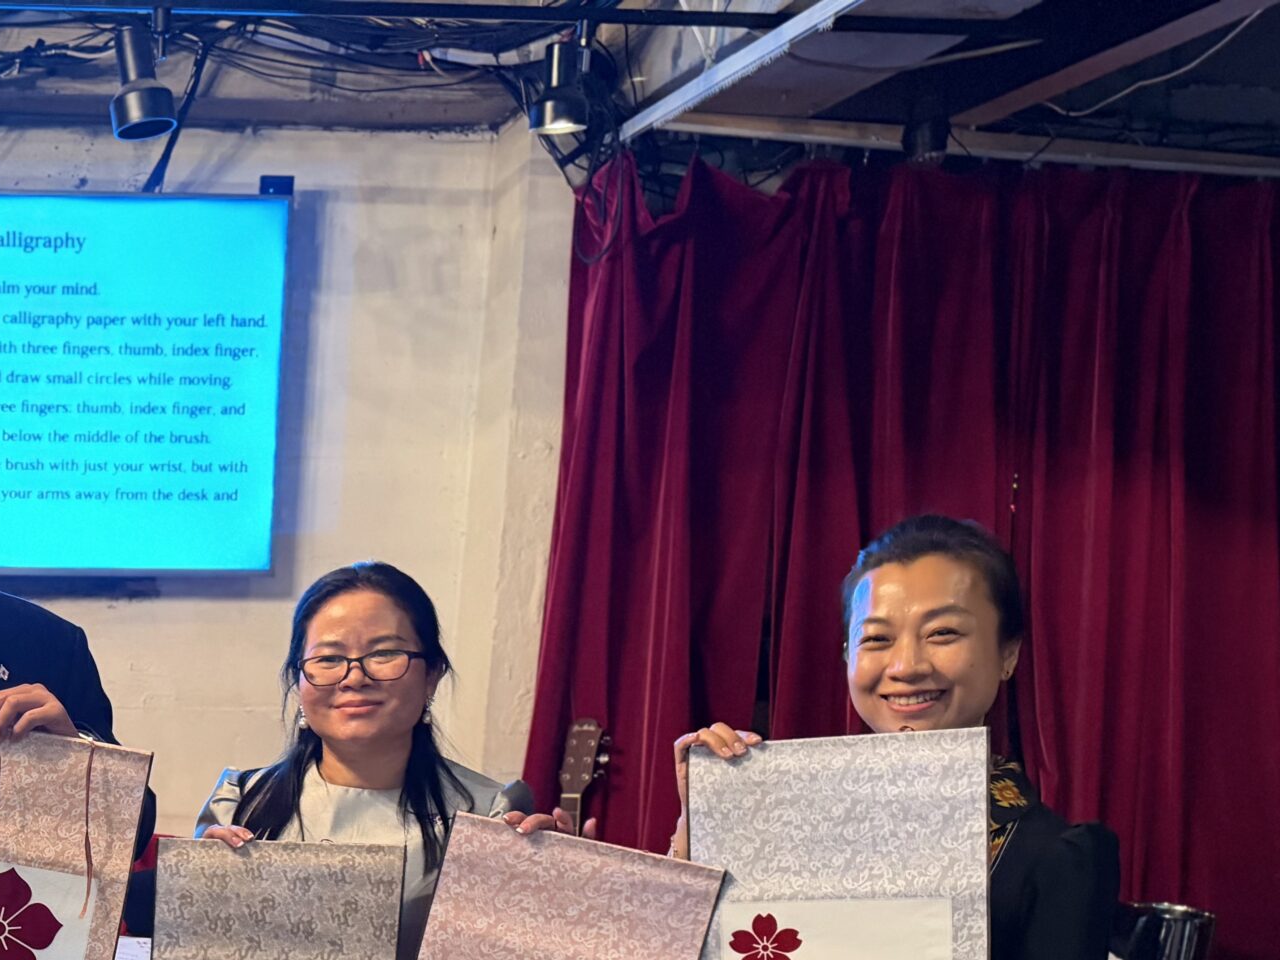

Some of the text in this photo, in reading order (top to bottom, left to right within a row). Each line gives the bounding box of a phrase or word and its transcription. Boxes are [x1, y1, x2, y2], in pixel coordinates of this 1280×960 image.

[24, 284, 56, 298] your
[61, 282, 100, 296] mind.
[2, 311, 82, 329] calligraphy
[86, 315, 125, 329] paper
[131, 313, 162, 327] with
[166, 316, 199, 331] your
[203, 313, 226, 327] left
[231, 314, 268, 328] hand.
[21, 341, 58, 355] three
[171, 343, 210, 357] index
[6, 370, 40, 384] draw
[45, 371, 83, 385] small
[87, 372, 132, 386] circles
[137, 372, 174, 386] while
[179, 373, 233, 390] moving.
[129, 402, 167, 415] index
[220, 403, 246, 416] and
[2, 429, 42, 442] below
[48, 430, 69, 443] the
[74, 430, 120, 443] middle
[125, 430, 140, 443] of
[144, 431, 165, 444] the
[170, 431, 210, 445] brush.
[6, 458, 44, 471] brush
[49, 459, 79, 472] with
[82, 459, 108, 475] just
[112, 461, 144, 476] your
[191, 460, 213, 473] but
[218, 460, 248, 474] with
[1, 489, 32, 503] your
[37, 489, 70, 500] arms
[75, 489, 110, 503] away
[115, 487, 148, 501] from
[152, 488, 173, 501] the
[178, 488, 208, 501] desk
[213, 488, 239, 501] and
